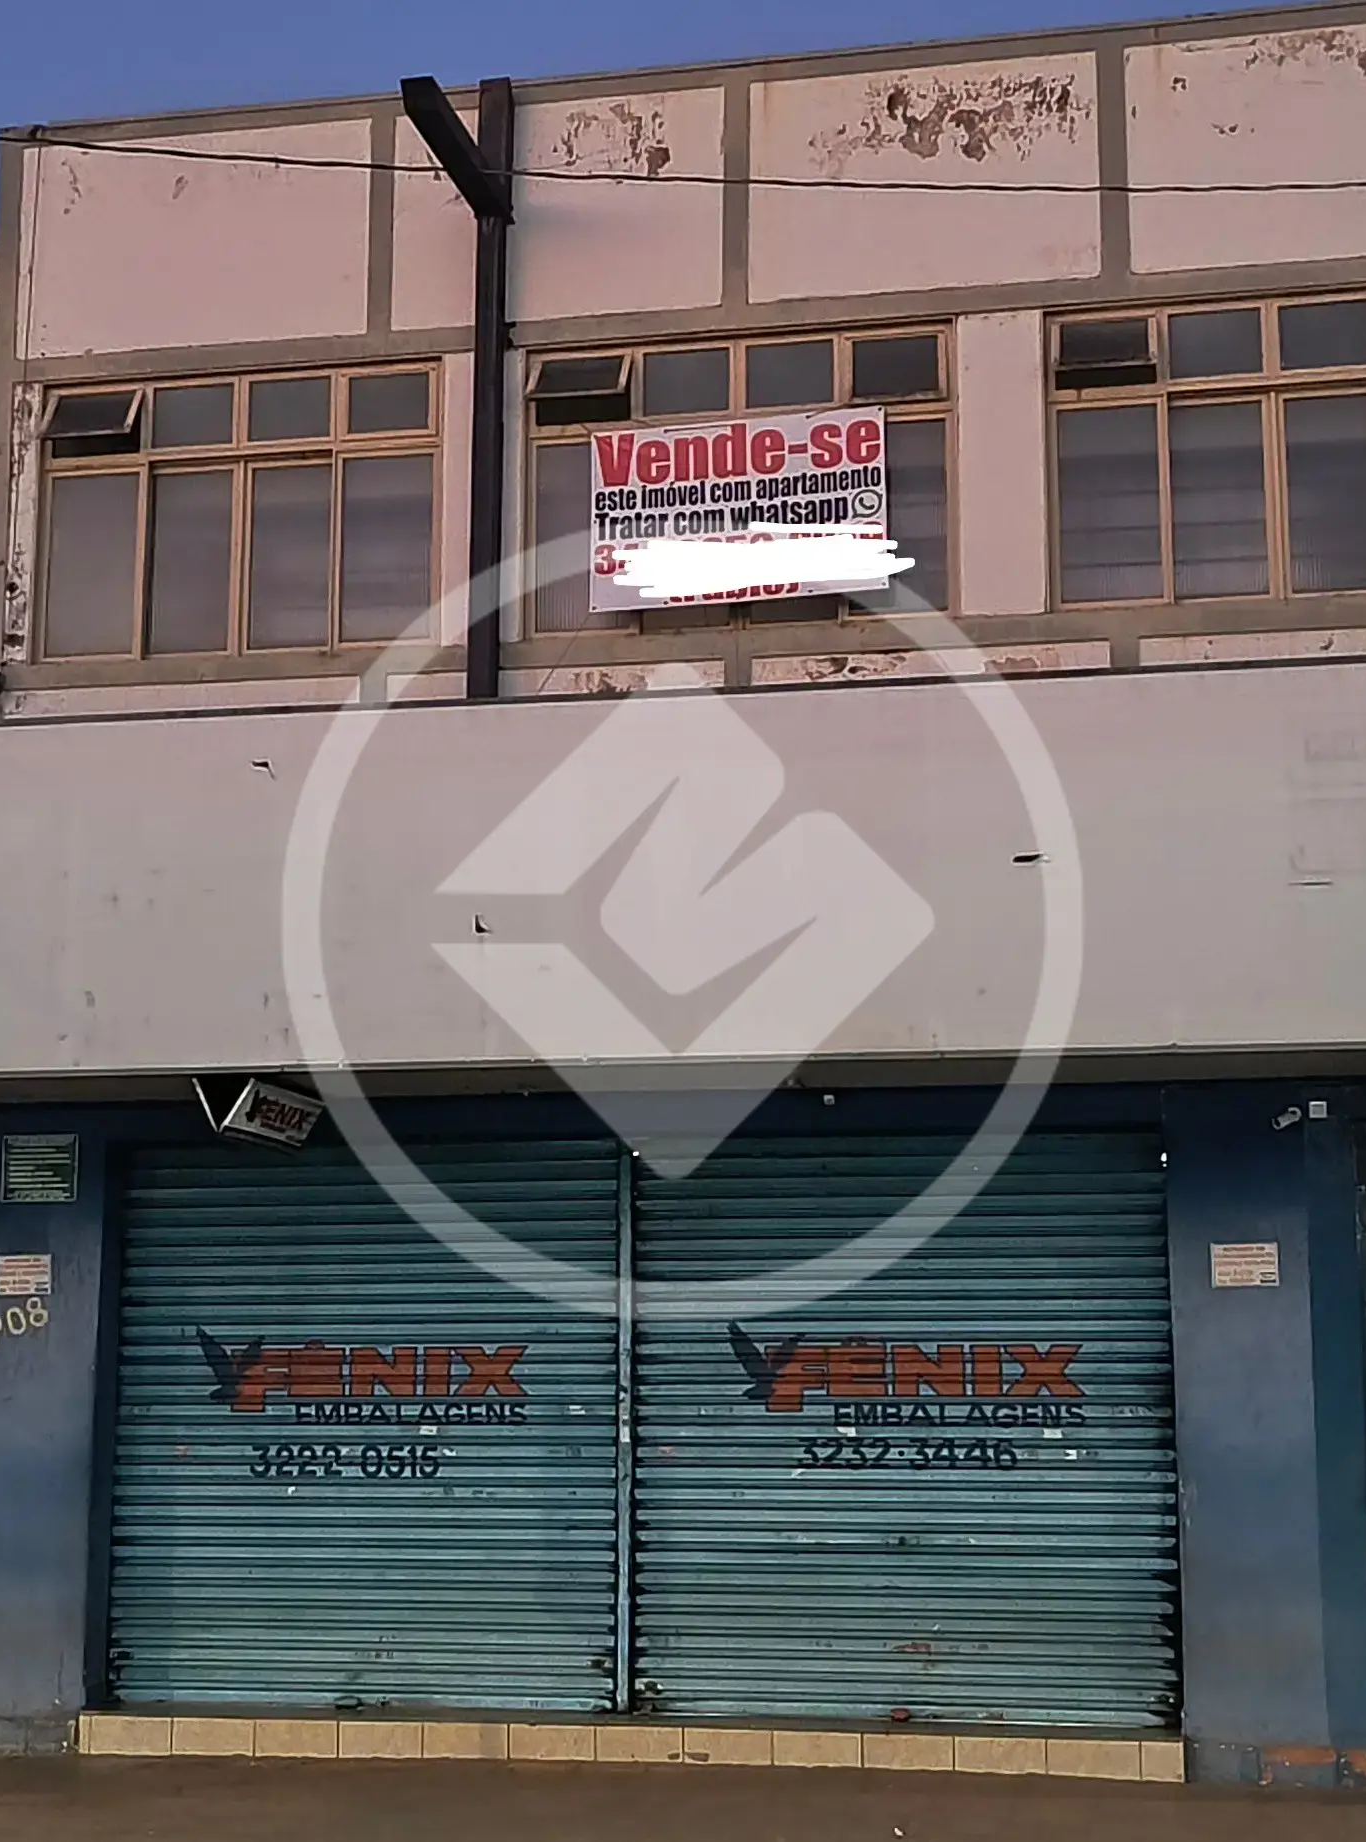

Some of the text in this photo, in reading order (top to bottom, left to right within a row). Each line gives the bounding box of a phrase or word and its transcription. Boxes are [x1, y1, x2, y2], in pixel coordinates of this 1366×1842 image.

[596, 418, 882, 487] Vende-se
[595, 464, 882, 513] este imóvel com apartamento
[594, 511, 669, 542] Tratar
[673, 508, 726, 538] com
[730, 495, 848, 531] whatsapp
[295, 1402, 528, 1424] EMBALAGENS
[834, 1402, 1087, 1428] EMBALAGENS
